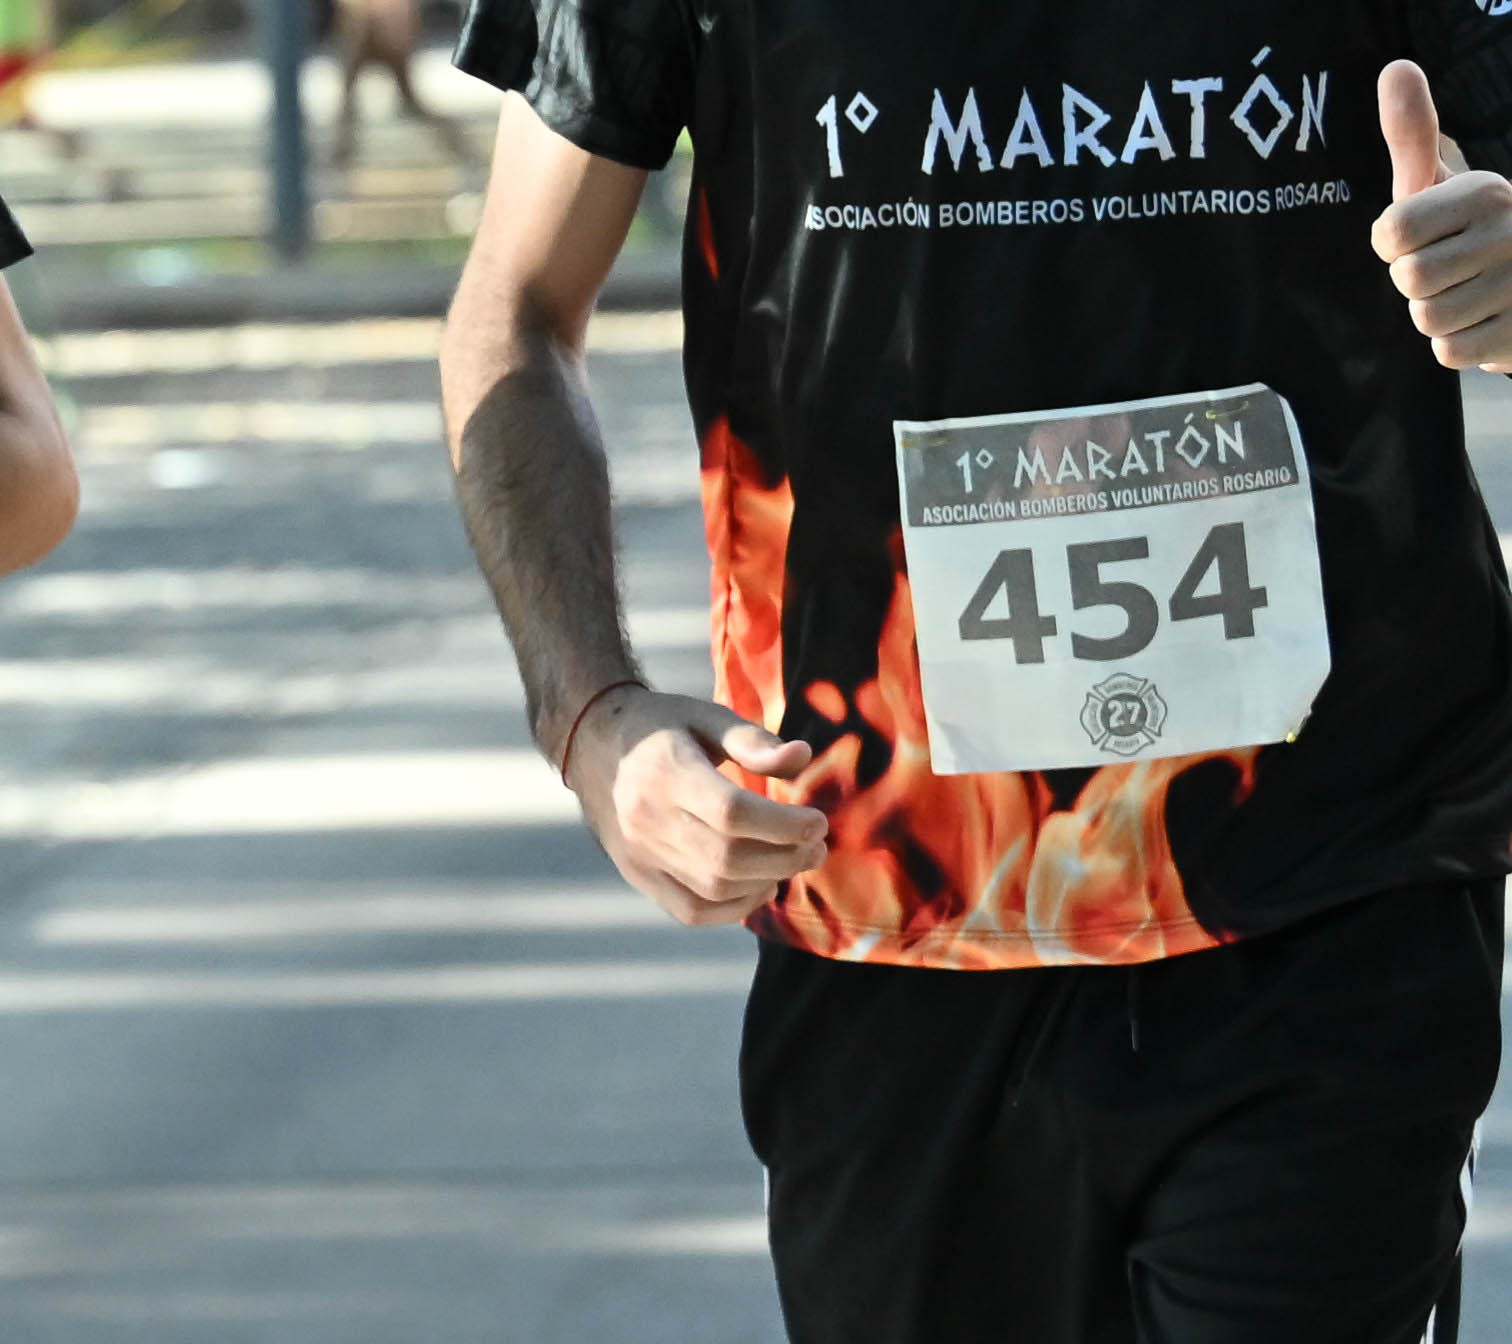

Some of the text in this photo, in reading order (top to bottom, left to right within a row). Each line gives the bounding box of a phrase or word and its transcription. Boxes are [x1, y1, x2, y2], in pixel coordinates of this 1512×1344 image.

[920, 46, 1329, 175] MARATÓN
[803, 179, 1351, 232] ASOCIACIÓN BOMBEROS VOLUNTARIOS ROSARIO
[1013, 412, 1245, 488] MARATÓN
[922, 465, 1292, 524] ASOCIACIÓN BOMBEROS VOLUNTARIOS ROSARIO
[958, 521, 1268, 665] 454
